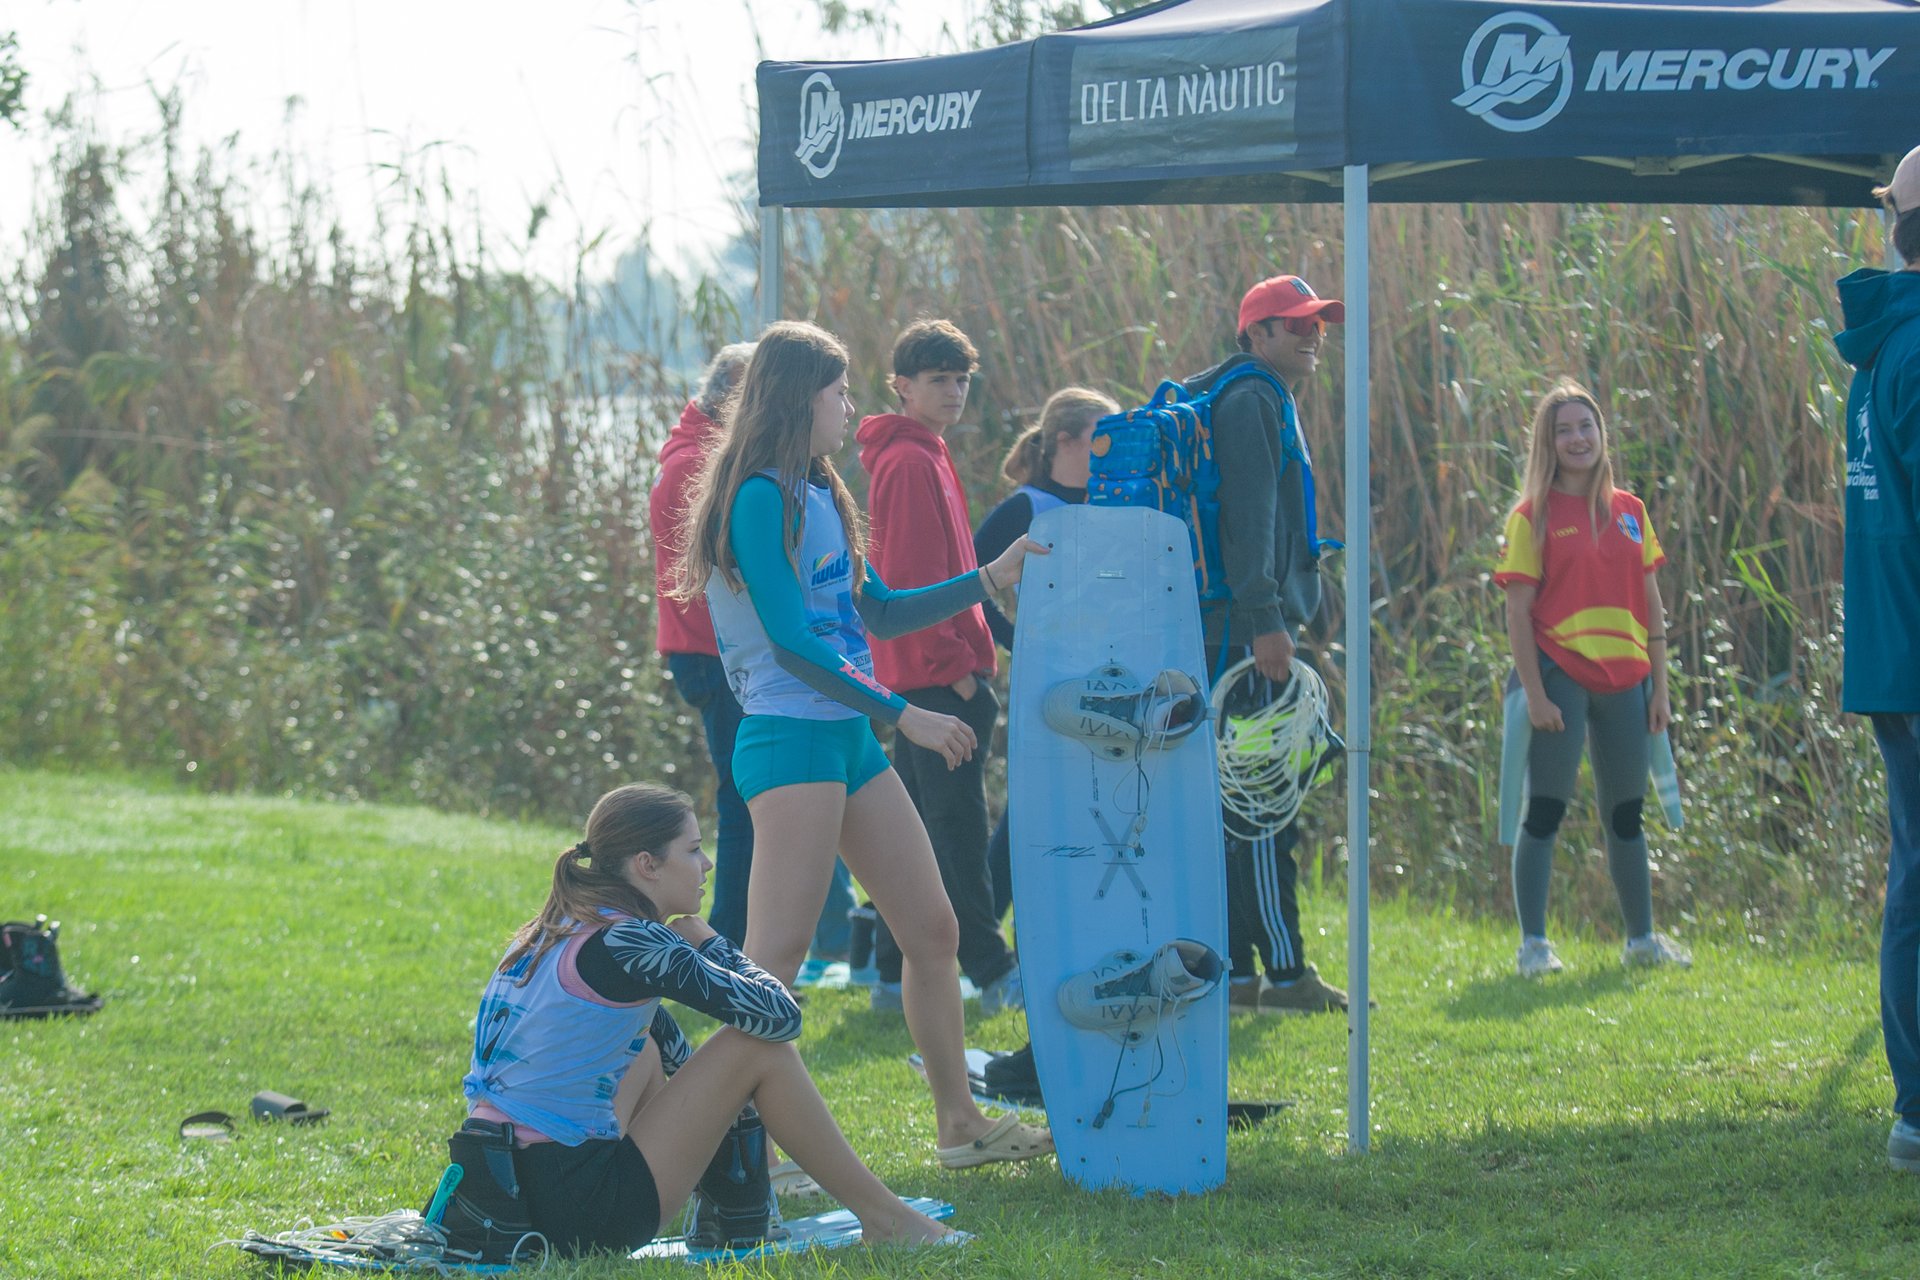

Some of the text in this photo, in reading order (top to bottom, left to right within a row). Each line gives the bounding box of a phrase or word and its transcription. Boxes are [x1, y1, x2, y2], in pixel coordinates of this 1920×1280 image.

[1080, 61, 1286, 125] DELTA NÀUTIC
[1584, 47, 1898, 92] MERCURY
[848, 89, 982, 140] MERCURY
